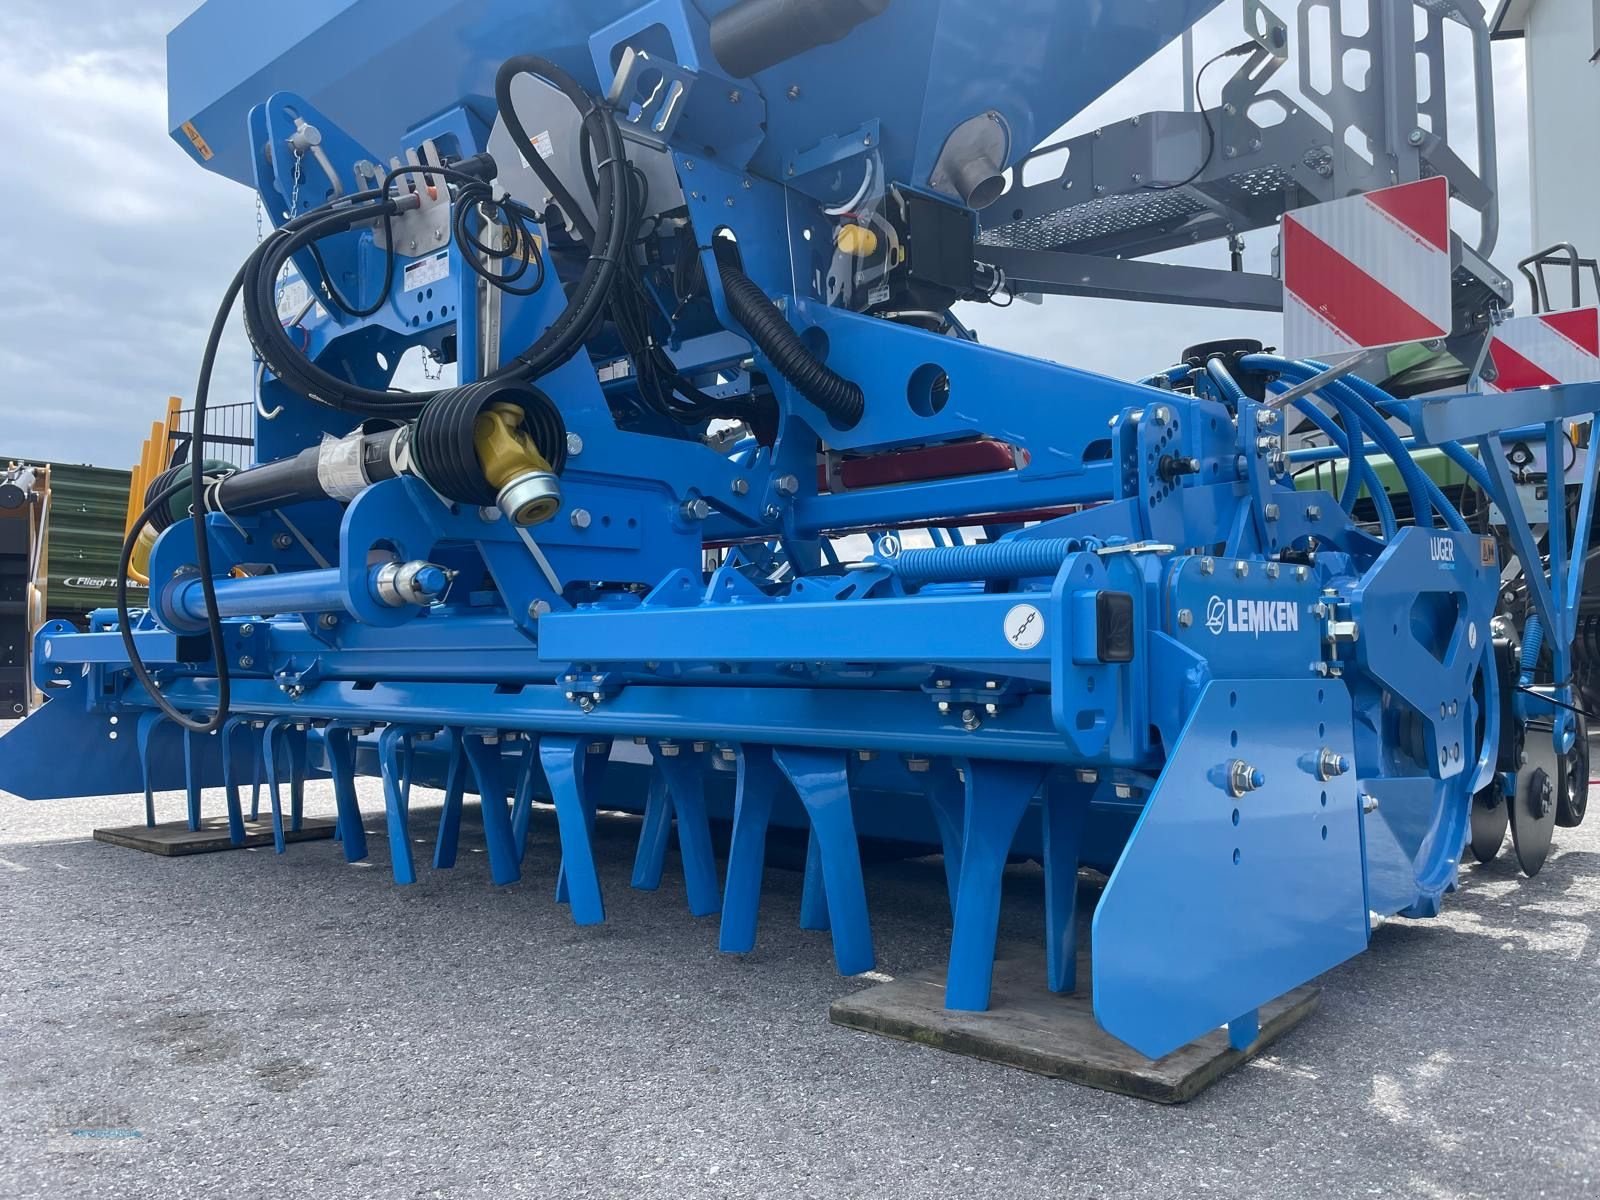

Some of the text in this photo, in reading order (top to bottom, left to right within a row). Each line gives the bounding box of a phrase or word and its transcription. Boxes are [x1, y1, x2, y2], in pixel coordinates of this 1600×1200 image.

[1430, 536, 1454, 561] LUGER
[76, 577, 107, 588] Fliegl
[1227, 599, 1298, 638] LEMKEN
